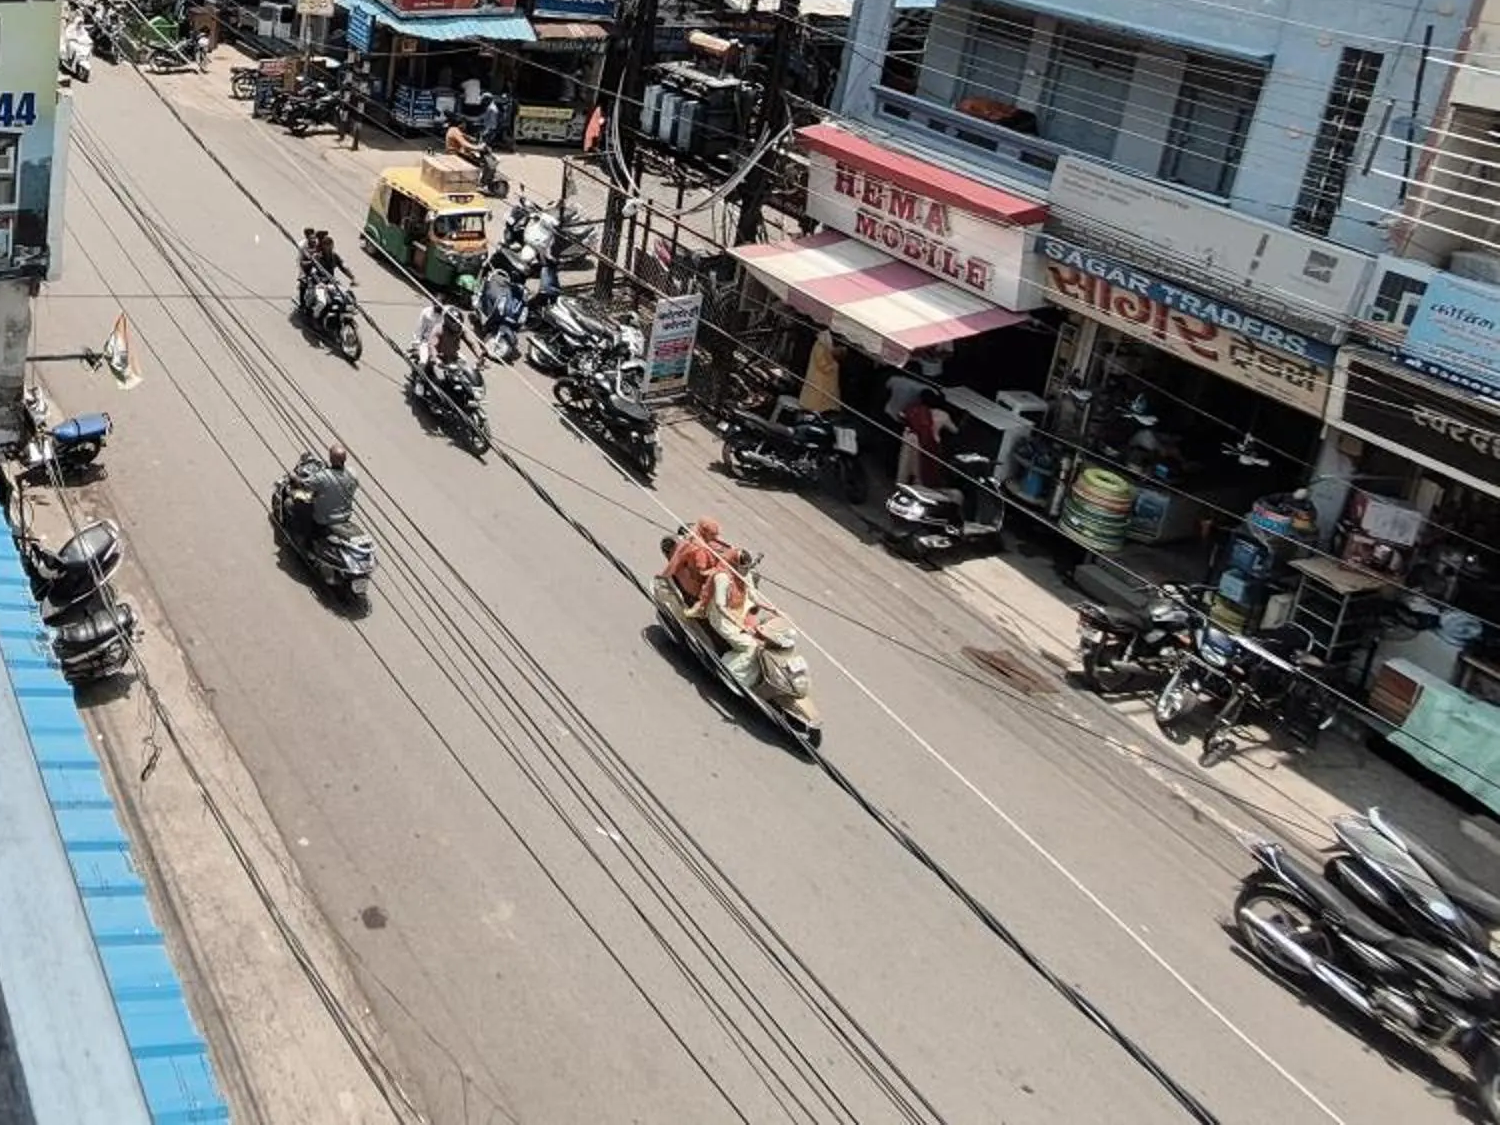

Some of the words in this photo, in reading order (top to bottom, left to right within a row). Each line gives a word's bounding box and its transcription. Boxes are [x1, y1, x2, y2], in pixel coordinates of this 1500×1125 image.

[835, 162, 949, 237] HEMA
[855, 209, 995, 292] MOBILE
[1044, 240, 1149, 295] SAGAR
[1159, 284, 1309, 356] TRADERS
[1049, 266, 1219, 362] सागर
